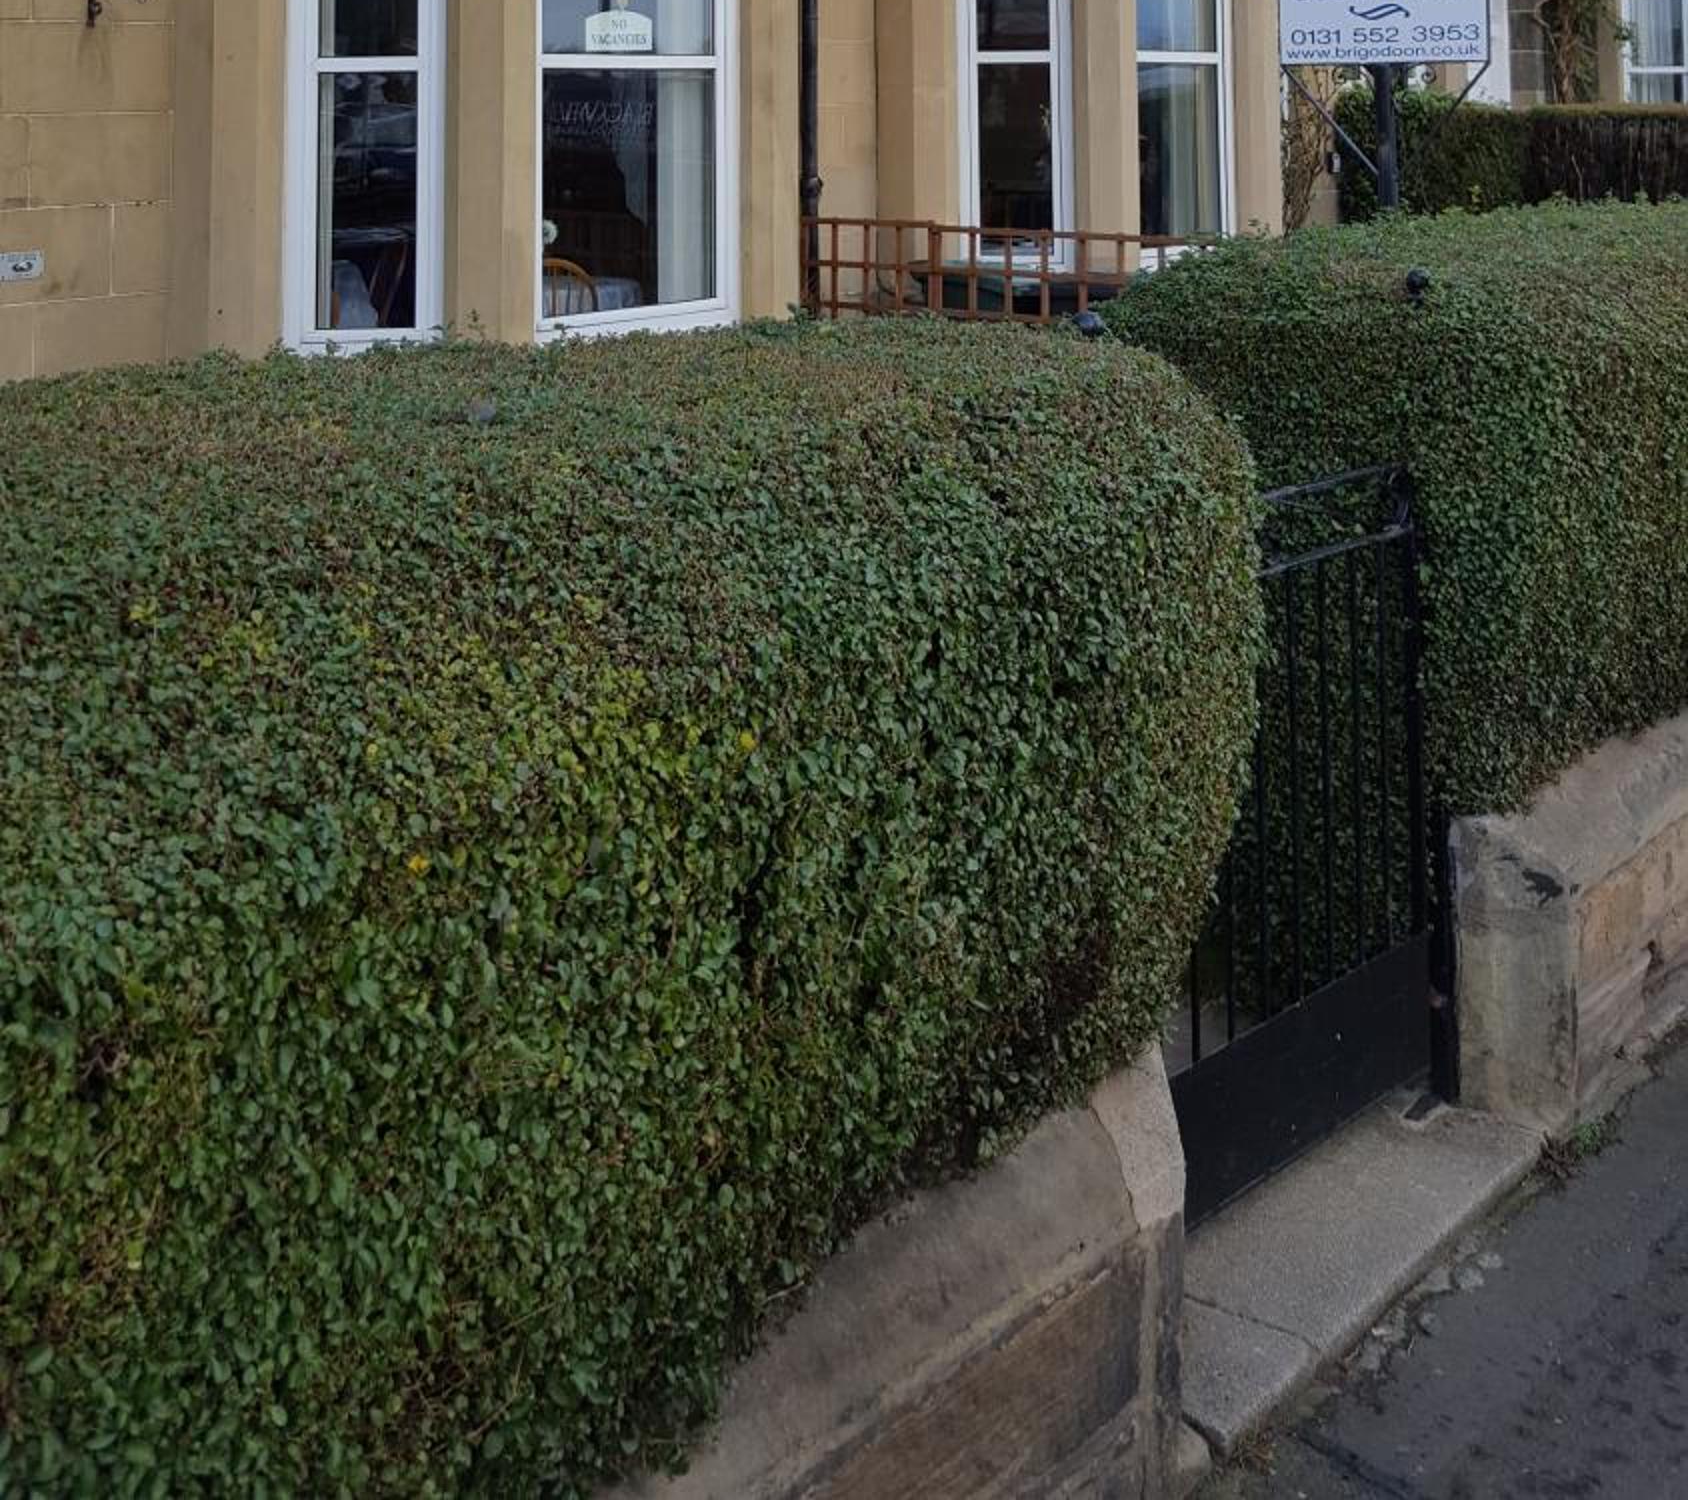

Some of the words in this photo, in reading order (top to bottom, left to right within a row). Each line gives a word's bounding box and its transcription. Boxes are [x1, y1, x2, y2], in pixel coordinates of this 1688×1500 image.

[611, 19, 627, 29] NO
[1291, 29, 1341, 45] 0131
[1353, 27, 1399, 43] 552
[1411, 23, 1480, 43] 3953
[1286, 43, 1481, 61] www.brigodoon.co.uk
